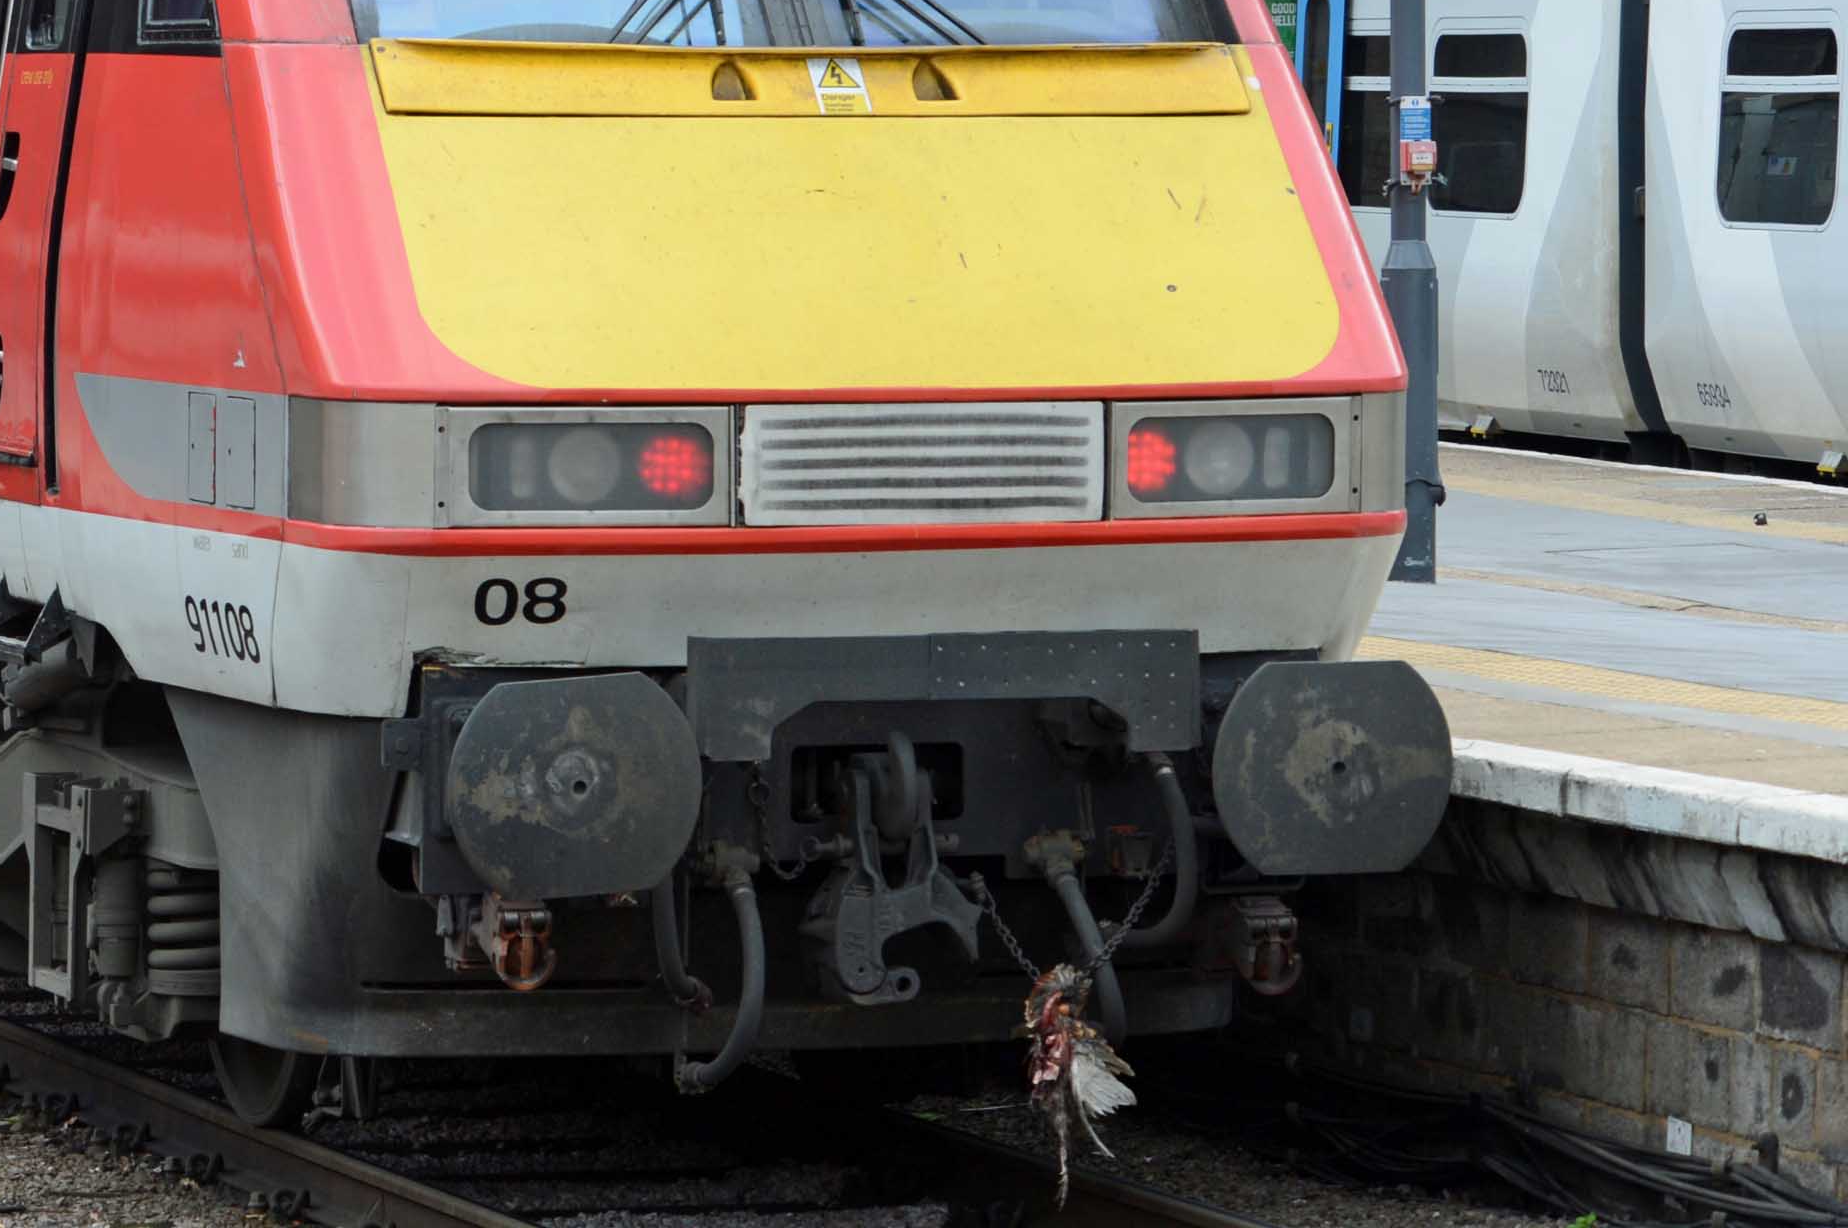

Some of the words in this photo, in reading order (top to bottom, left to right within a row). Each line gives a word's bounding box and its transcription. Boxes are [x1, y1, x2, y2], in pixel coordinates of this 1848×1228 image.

[1271, 2, 1296, 14] GOOD
[1537, 369, 1571, 395] 72321
[474, 577, 568, 626] 08
[185, 595, 260, 663] 91108
